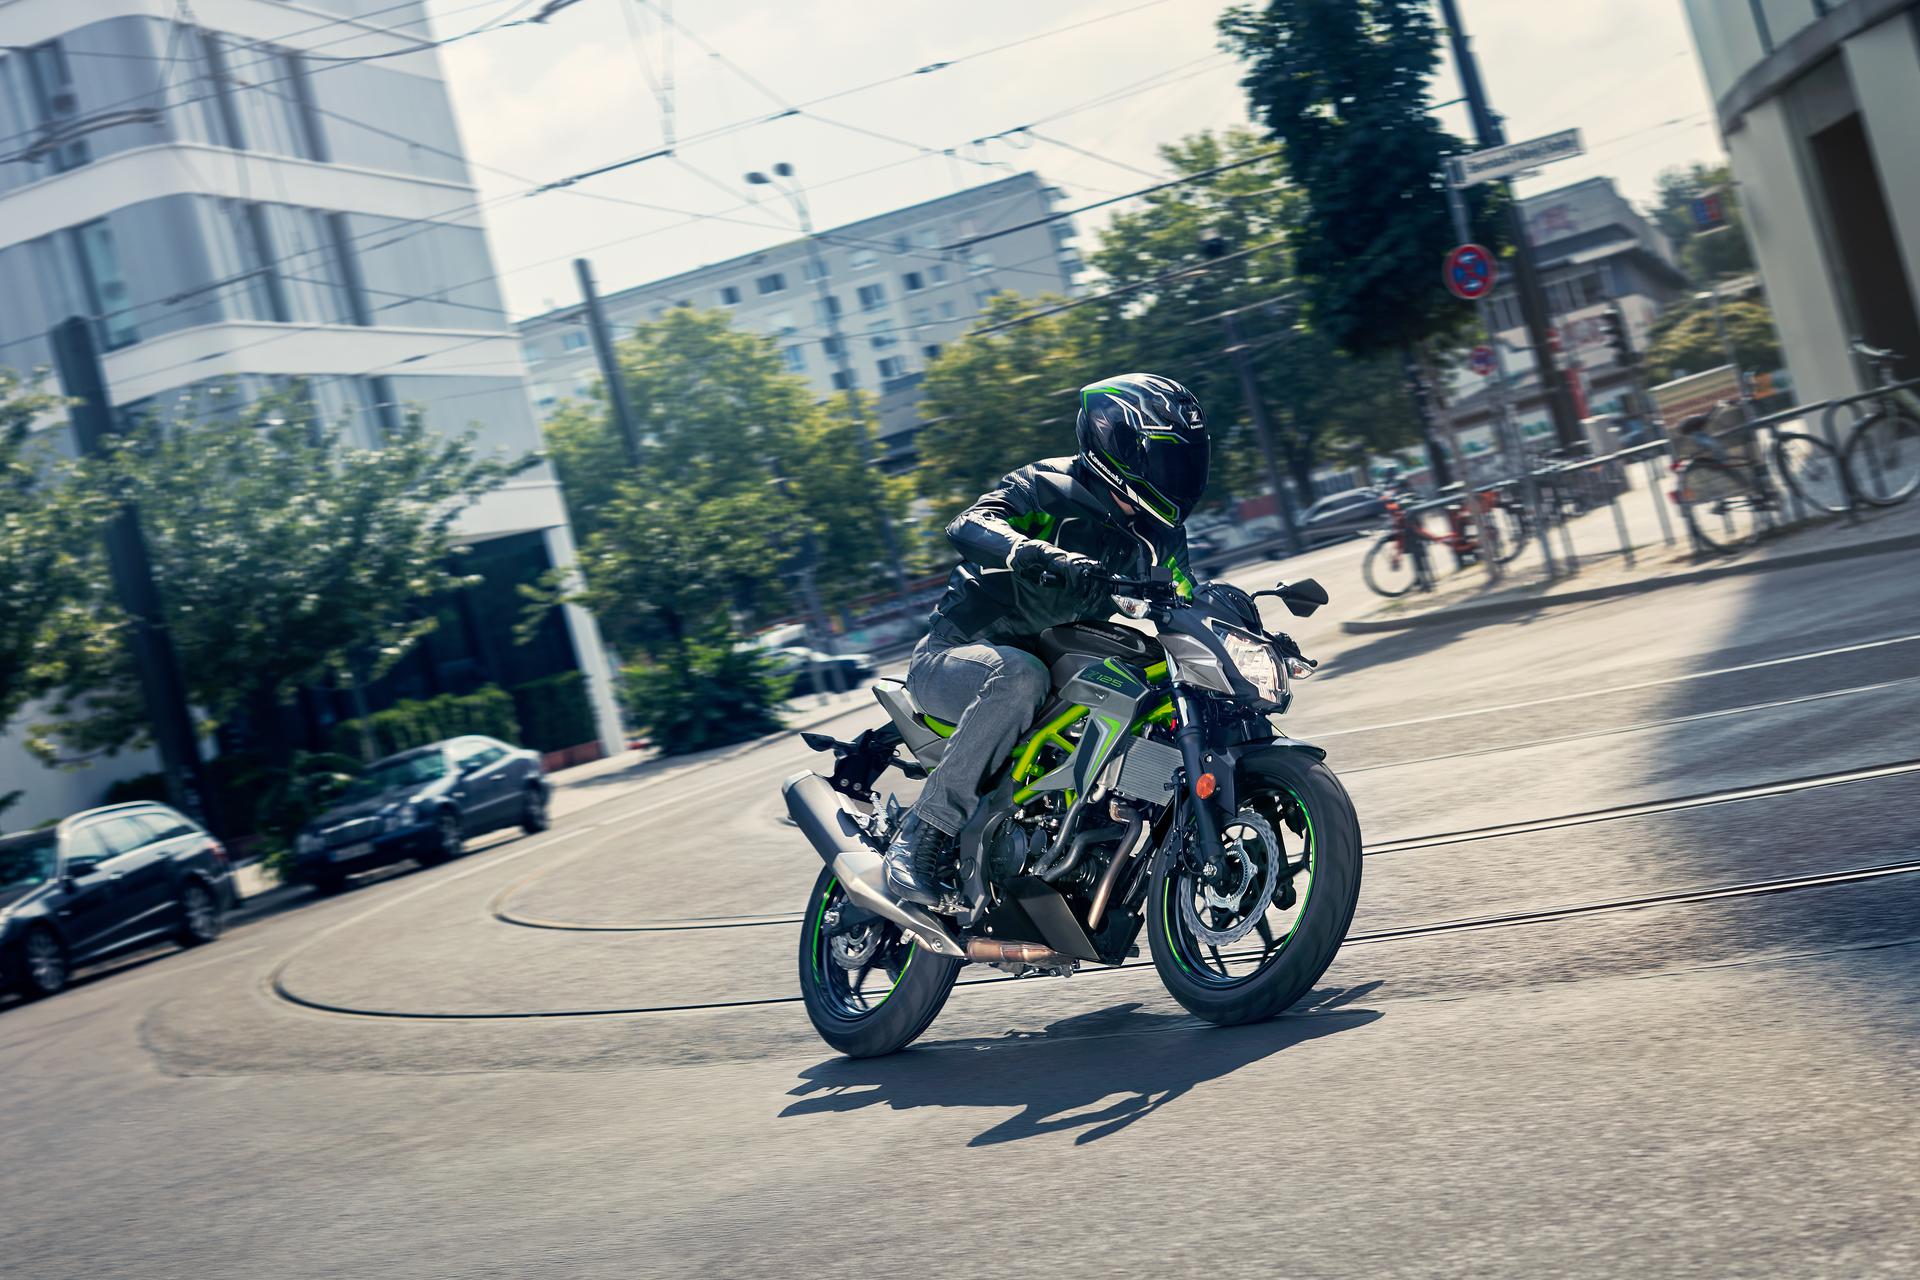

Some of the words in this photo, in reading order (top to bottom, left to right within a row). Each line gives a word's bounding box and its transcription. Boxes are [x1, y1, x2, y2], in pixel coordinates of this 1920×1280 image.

[1188, 411, 1201, 423] Z
[1088, 450, 1123, 486] Kawasaki
[1073, 624, 1125, 641] Kawasaki
